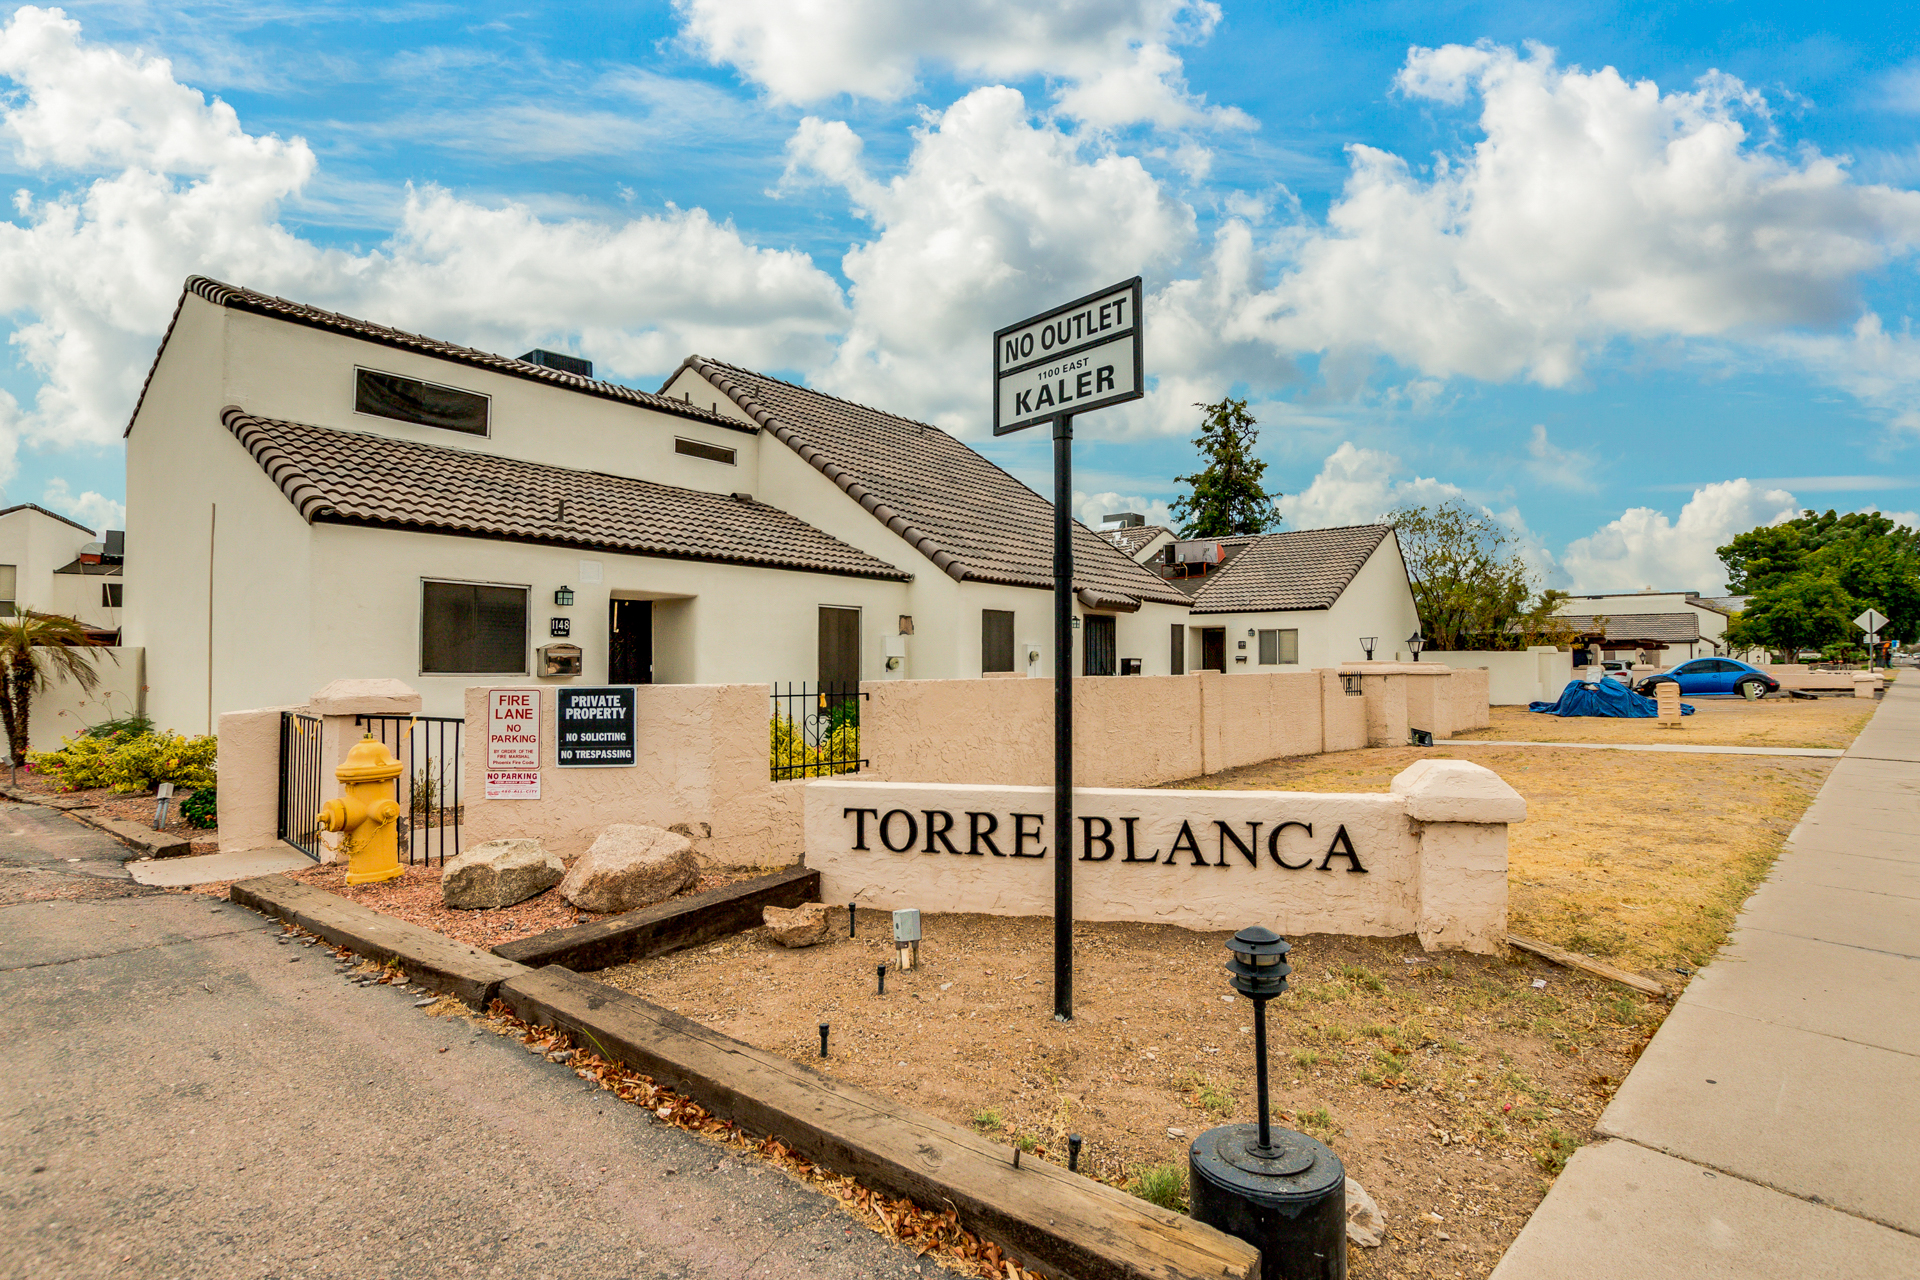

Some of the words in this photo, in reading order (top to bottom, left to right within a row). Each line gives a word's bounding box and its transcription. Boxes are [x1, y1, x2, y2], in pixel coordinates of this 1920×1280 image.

[1005, 332, 1034, 364] NO
[1041, 297, 1127, 350] OUTLET
[1038, 366, 1060, 381] 1100
[1062, 357, 1089, 373] EAST
[1015, 364, 1115, 416] KALER
[552, 620, 570, 630] 1148
[499, 695, 530, 706] FIRE
[571, 695, 621, 707] PRIVATE
[495, 708, 534, 720] LANE
[565, 707, 627, 720] PROPERTY
[506, 724, 521, 733] NO
[491, 734, 537, 743] PARKING
[565, 733, 578, 742] NO
[580, 732, 627, 742] SOLICITING
[560, 750, 573, 759] NO
[575, 749, 632, 759] TRESPASSING
[843, 807, 1048, 859] TORRE
[1078, 815, 1369, 874] BLANCA
